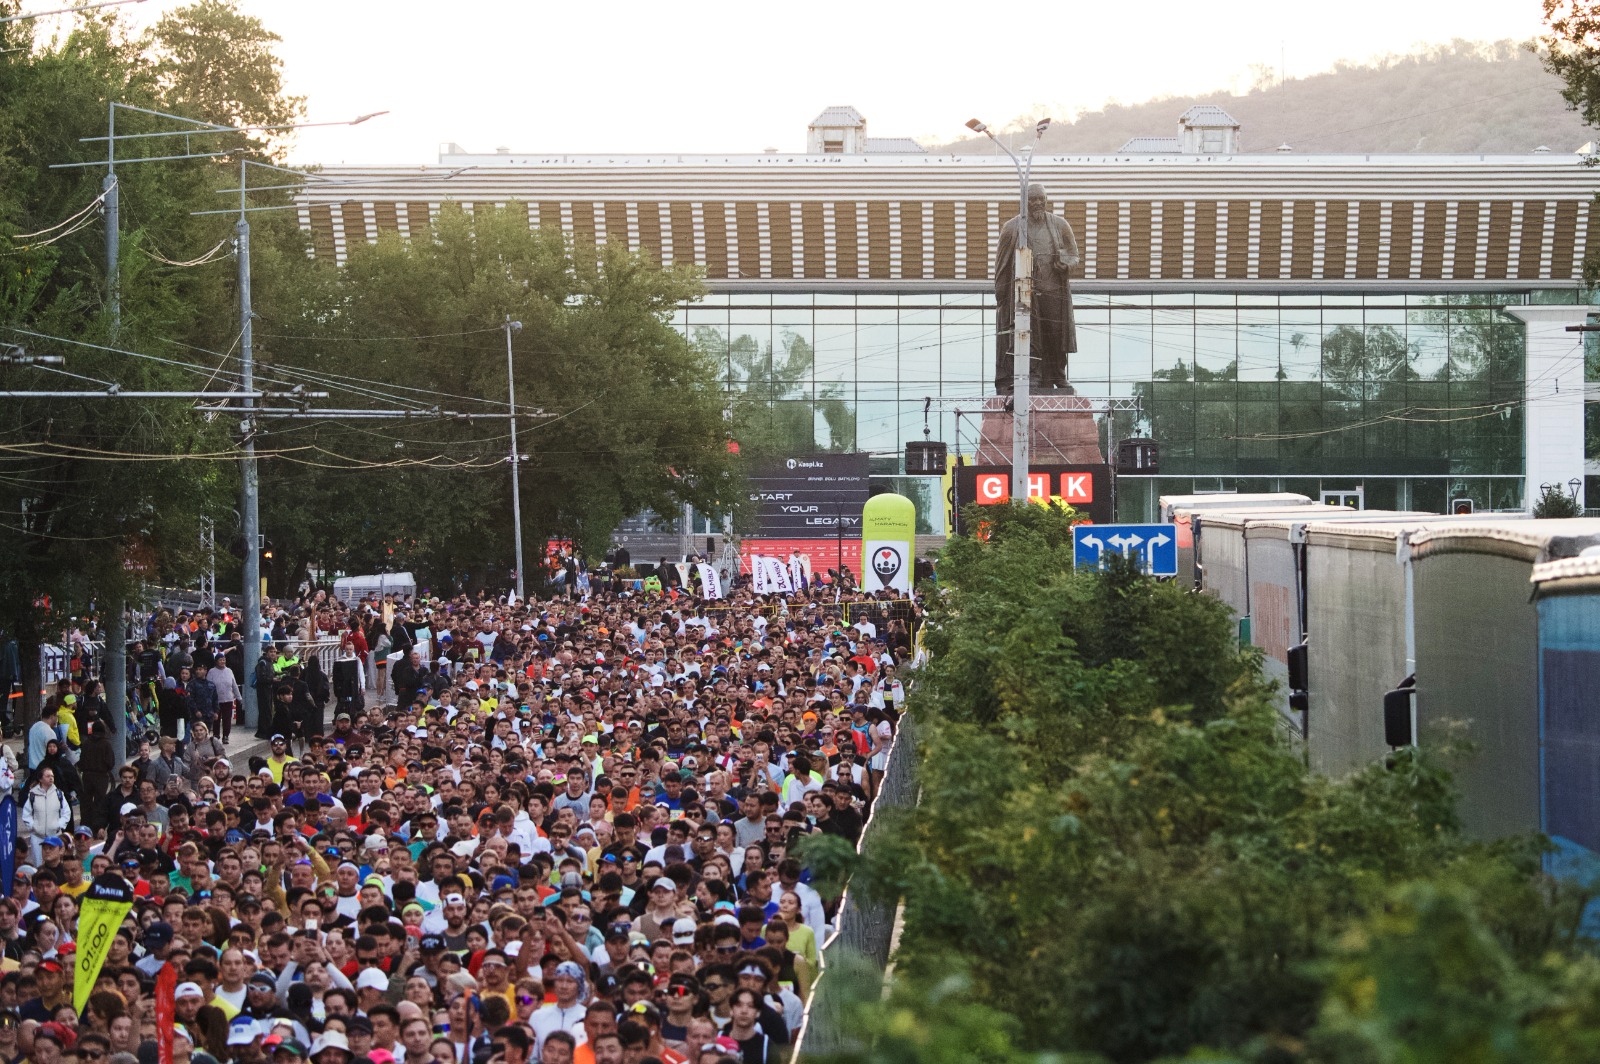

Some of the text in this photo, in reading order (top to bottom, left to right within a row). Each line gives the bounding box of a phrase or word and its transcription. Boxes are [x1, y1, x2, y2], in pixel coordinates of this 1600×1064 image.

[983, 476, 1087, 499] G H K
[781, 505, 819, 513] YOUR
[81, 923, 107, 972] 01:00
